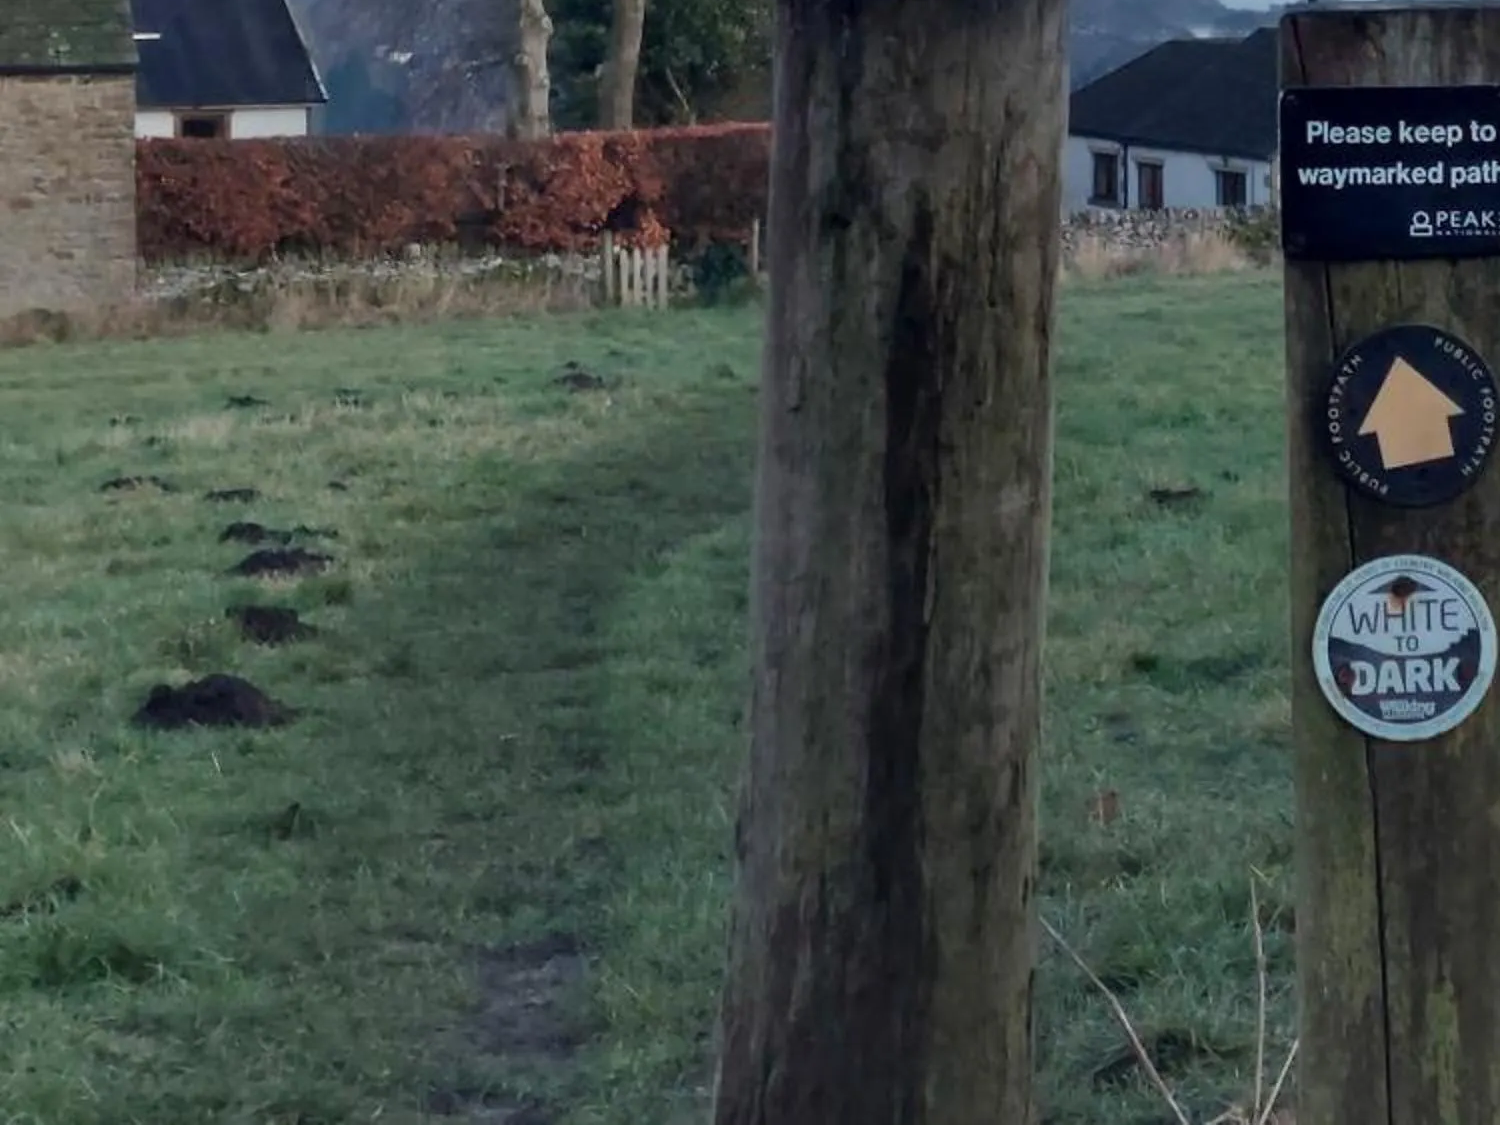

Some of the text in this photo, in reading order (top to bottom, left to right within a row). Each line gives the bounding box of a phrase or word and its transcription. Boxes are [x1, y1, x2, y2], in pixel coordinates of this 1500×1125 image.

[1306, 120, 1497, 148] Please keep to
[1298, 161, 1444, 190] waymarked
[1436, 210, 1495, 227] PEAK
[1434, 336, 1496, 476] PUBLIC FOOTPATH
[1327, 354, 1390, 495] PUBLIC FOOTPATH
[1347, 597, 1460, 635] WHITE
[1393, 635, 1419, 652] TO
[1350, 656, 1461, 695] DARK
